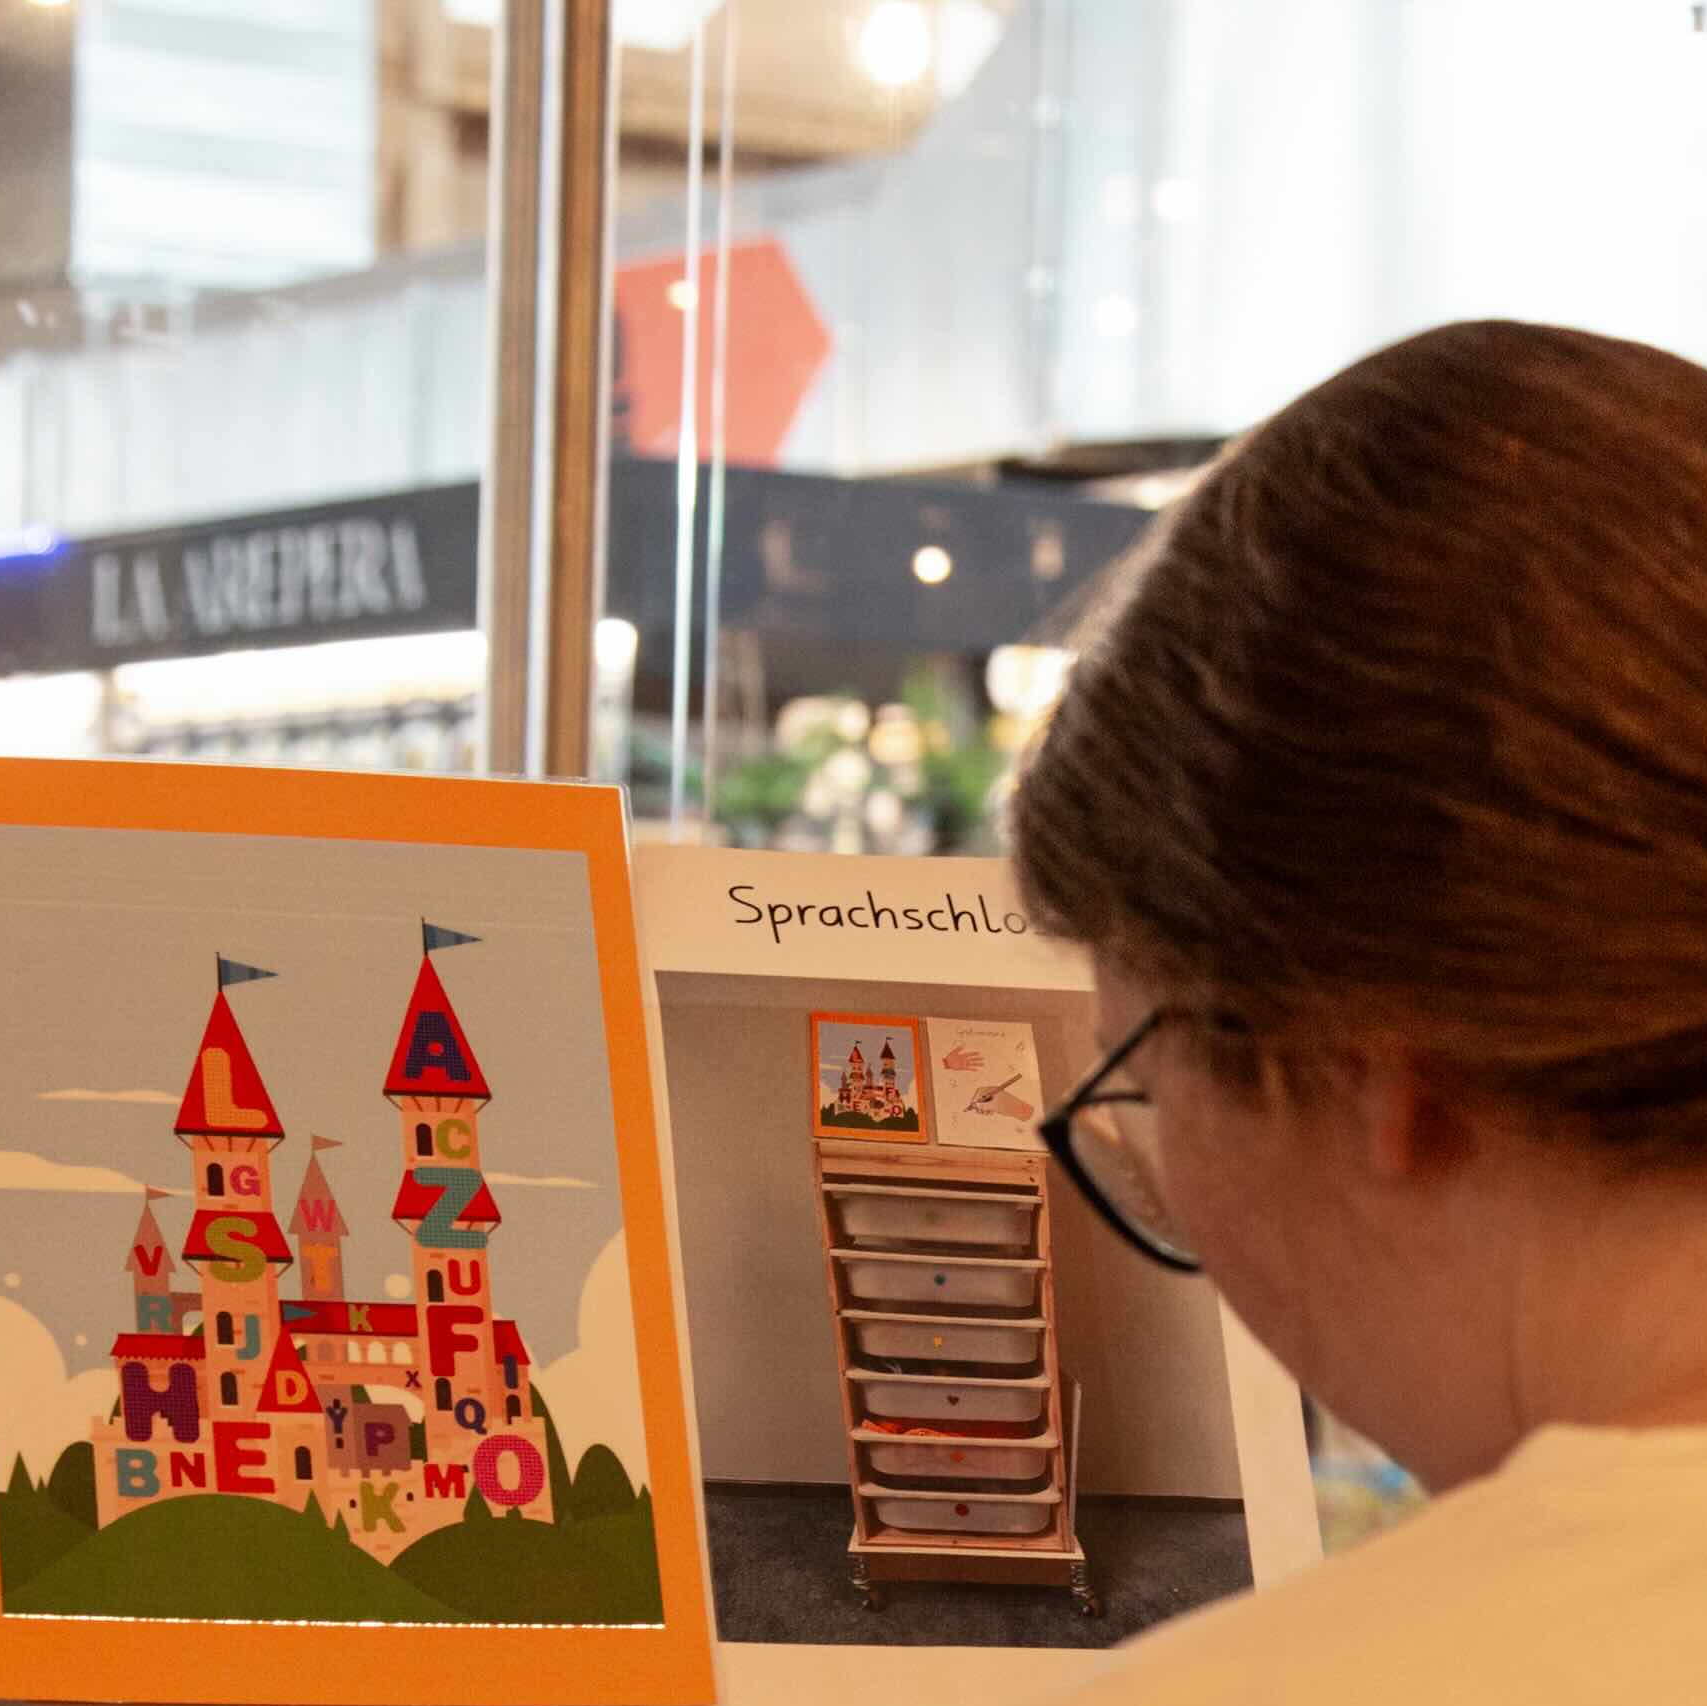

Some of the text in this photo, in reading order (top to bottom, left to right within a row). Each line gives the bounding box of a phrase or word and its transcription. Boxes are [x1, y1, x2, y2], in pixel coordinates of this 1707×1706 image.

[93, 550, 172, 648] LA
[727, 885, 1039, 945] Sprachschlo
[403, 1009, 473, 1084] A
[200, 1047, 268, 1129] L
[434, 1118, 474, 1161] C
[229, 1165, 262, 1198] G
[298, 1199, 340, 1233] W
[411, 1167, 489, 1249] Z
[133, 1244, 166, 1278] V
[205, 1216, 267, 1284] S
[447, 1258, 482, 1297] U
[136, 1294, 173, 1333] R
[235, 1313, 262, 1361] J
[348, 1304, 373, 1334] K
[426, 1304, 485, 1378] F
[119, 1361, 203, 1444] H
[274, 1370, 308, 1405] D
[363, 1422, 398, 1457] P
[454, 1397, 488, 1435] Q
[117, 1448, 161, 1499] B
[169, 1451, 208, 1489] N
[212, 1422, 277, 1496] E
[422, 1463, 468, 1500] M
[472, 1434, 547, 1508] O
[358, 1481, 407, 1535] K
